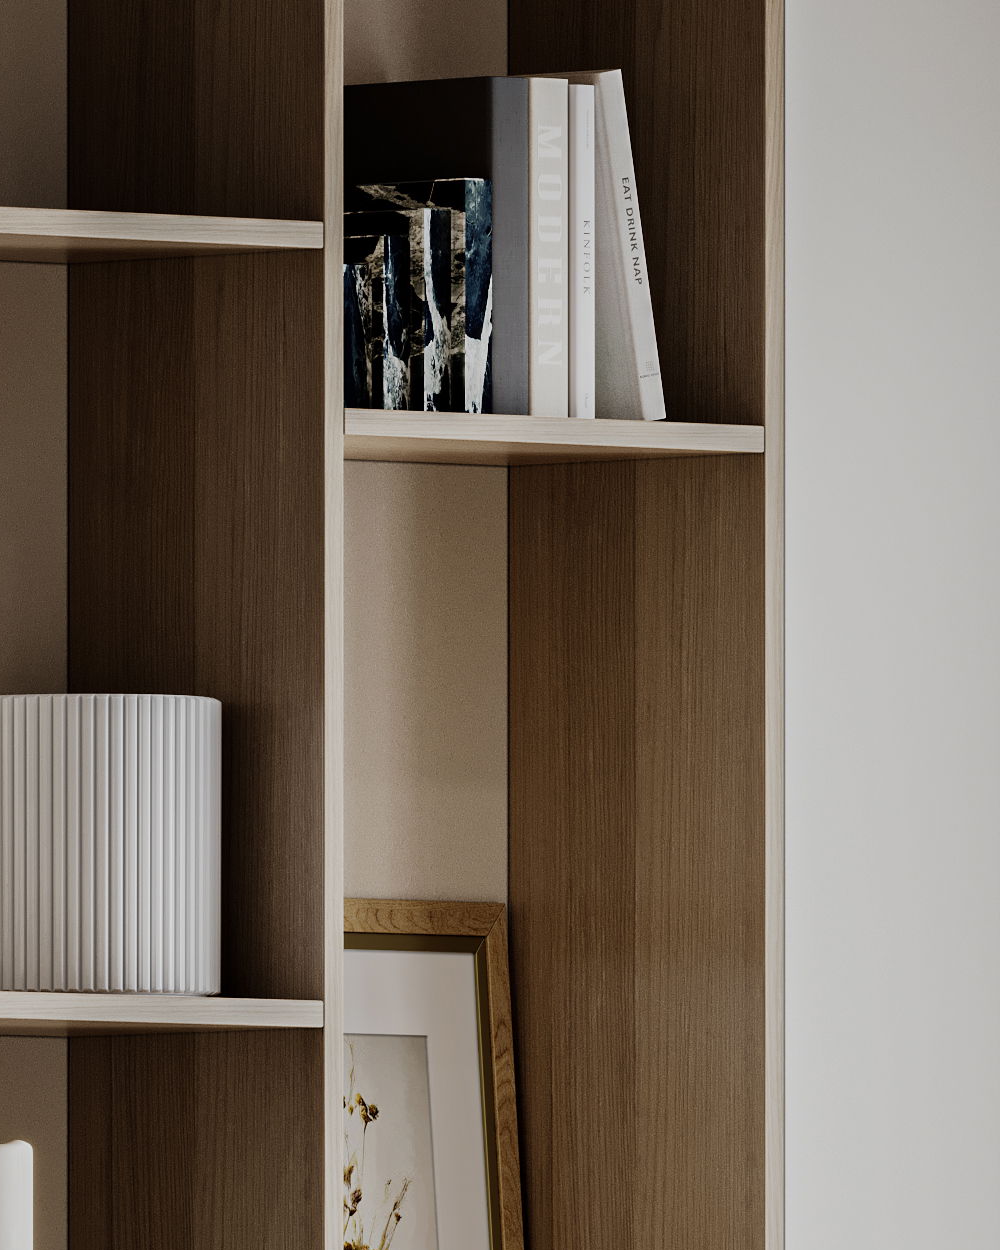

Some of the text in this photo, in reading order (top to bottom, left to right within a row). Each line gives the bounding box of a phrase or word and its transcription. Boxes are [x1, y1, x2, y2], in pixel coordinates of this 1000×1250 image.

[537, 123, 563, 368] MODERN
[583, 220, 592, 297] KINFOLK
[621, 177, 644, 286] EAT DRINK NAP
